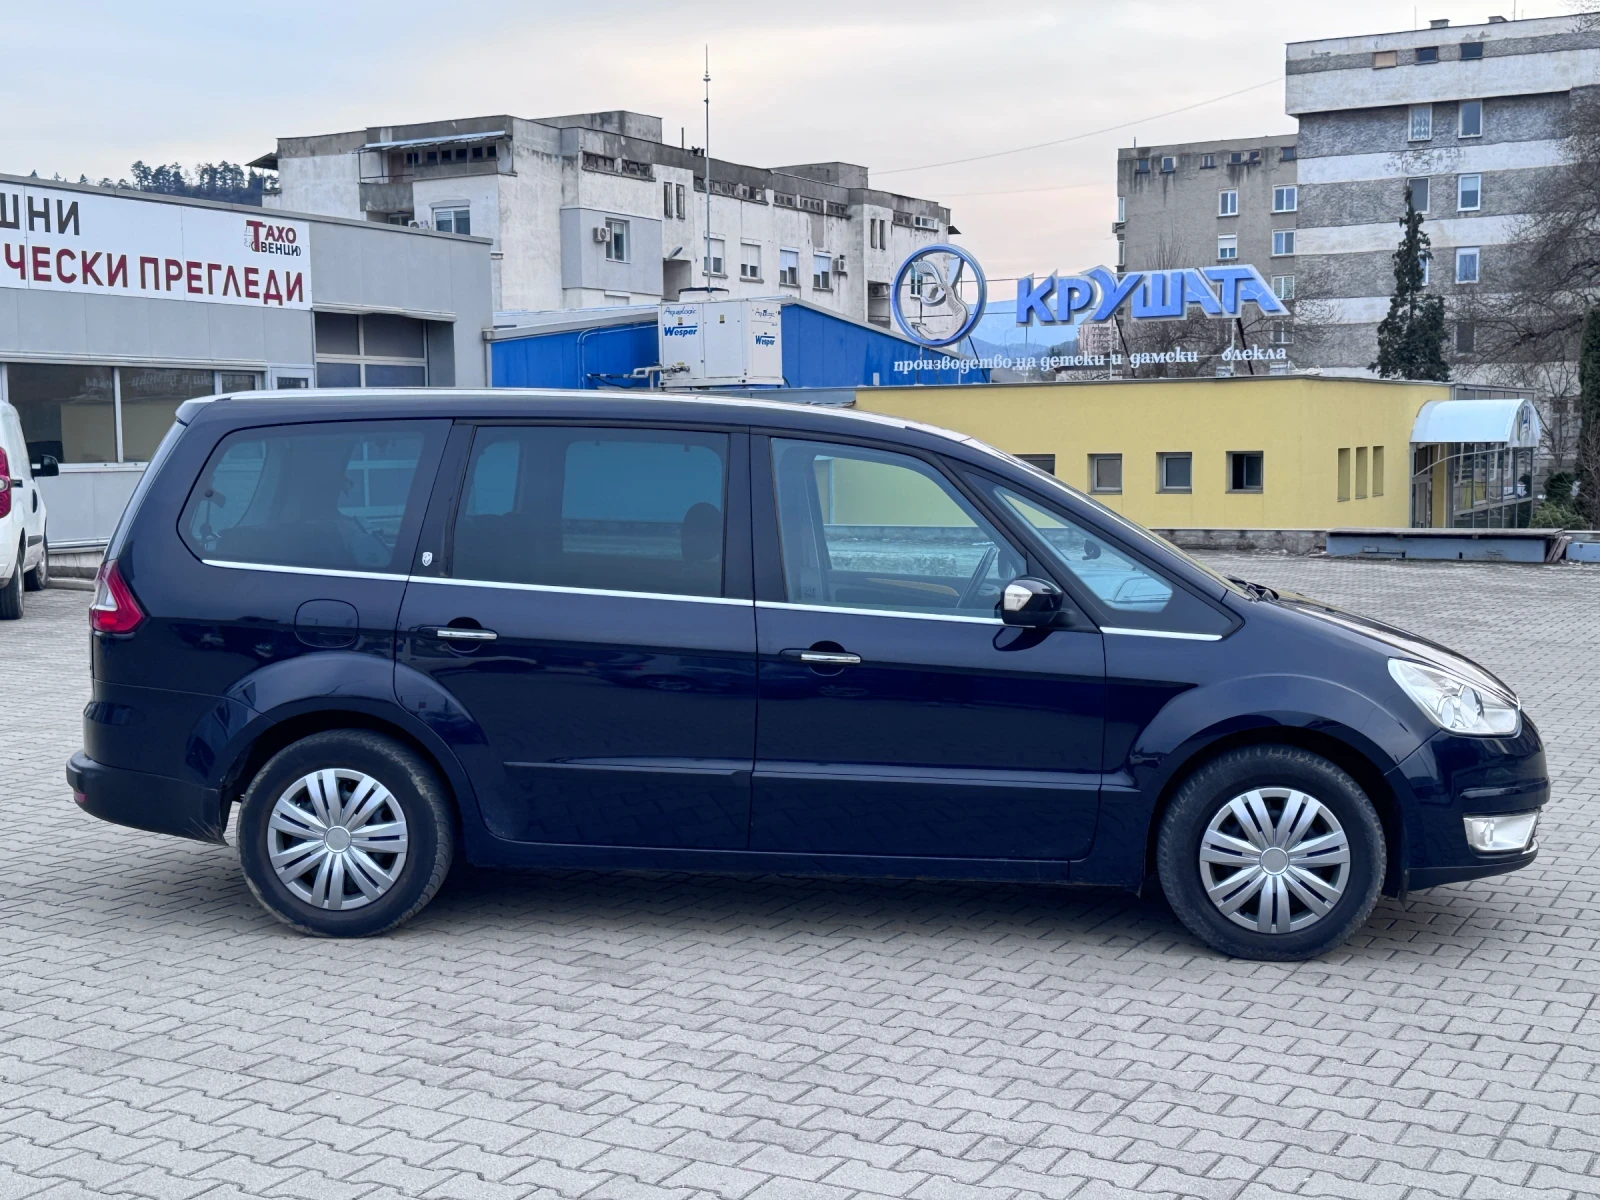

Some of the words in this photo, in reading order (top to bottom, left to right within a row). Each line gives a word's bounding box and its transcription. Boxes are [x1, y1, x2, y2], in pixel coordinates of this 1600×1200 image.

[246, 220, 297, 252] ТАХО
[4, 243, 128, 288] ЧЕСКИ
[139, 256, 304, 306] ПРЕГЛЕДИ
[1016, 265, 1288, 326] КРУШАТА
[664, 326, 698, 337] Wesper
[893, 354, 1013, 375] производство
[1015, 355, 1037, 369] на
[1040, 350, 1105, 372] детски
[1111, 352, 1123, 365] и
[1130, 346, 1199, 369] дамски
